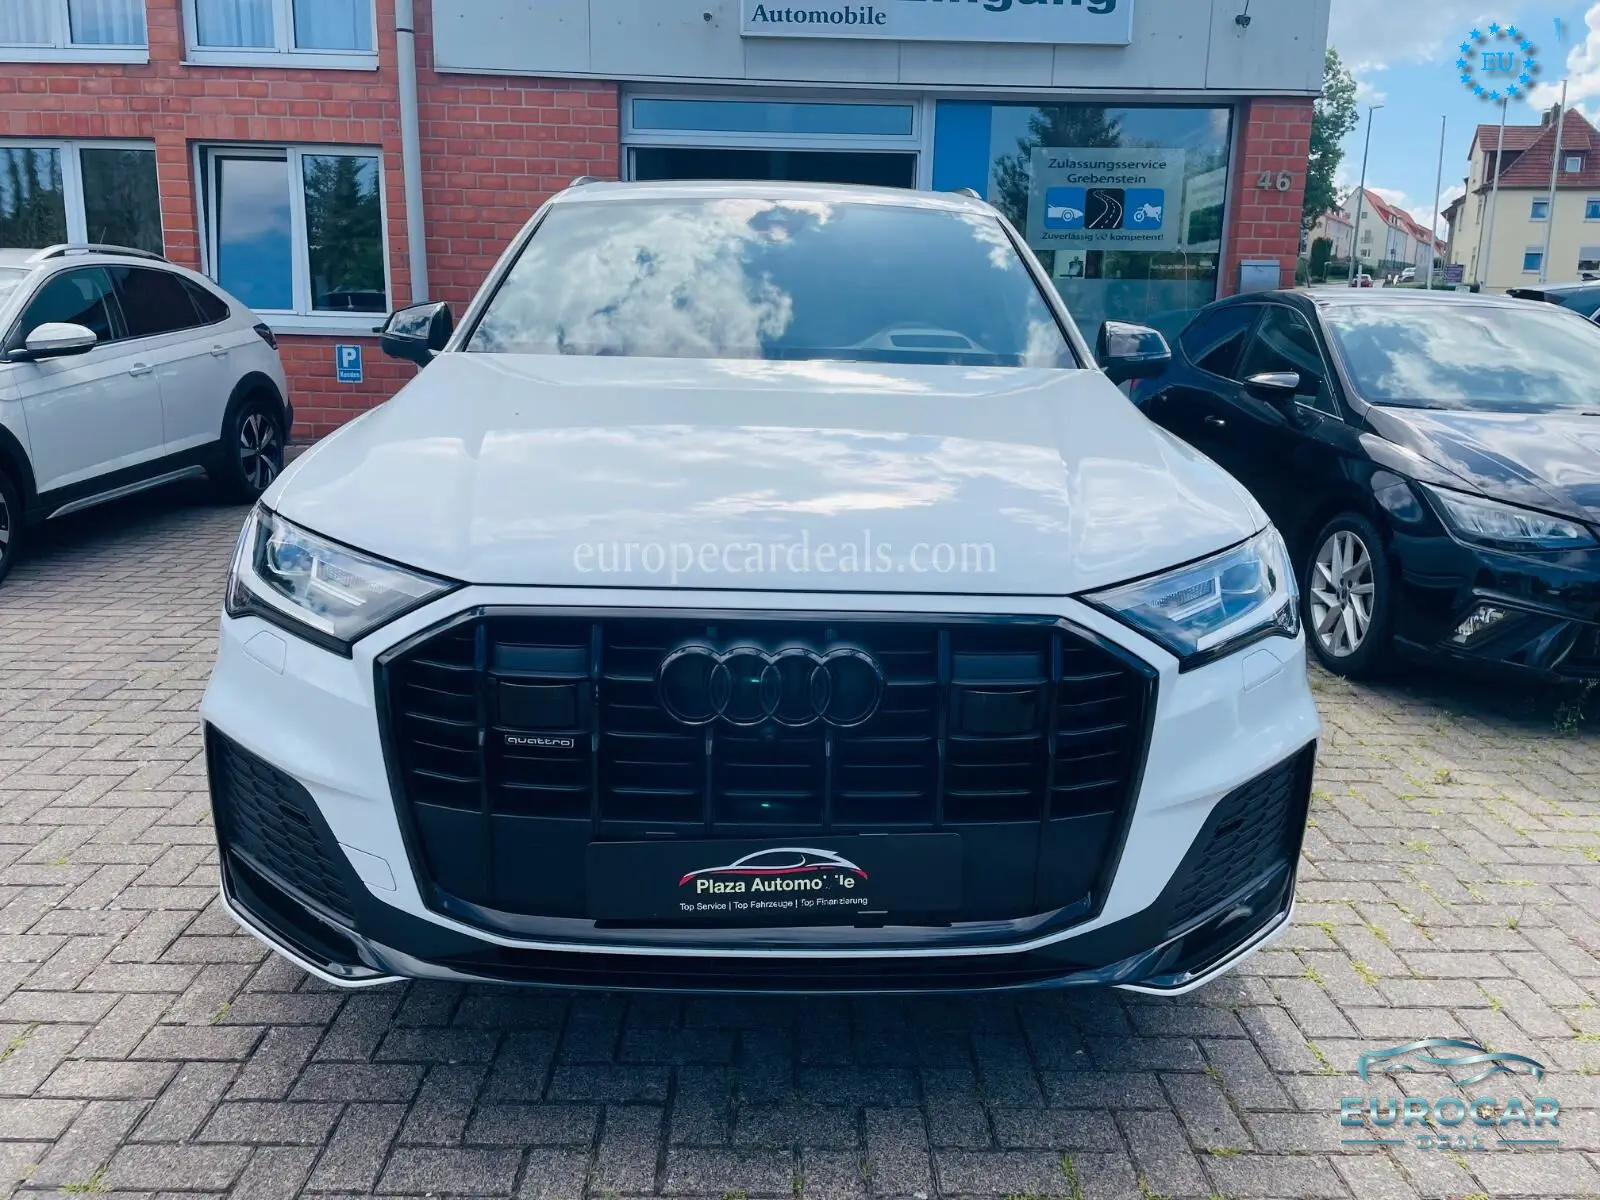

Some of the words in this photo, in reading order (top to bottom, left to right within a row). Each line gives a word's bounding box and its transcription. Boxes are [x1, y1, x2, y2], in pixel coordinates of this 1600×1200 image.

[752, 4, 887, 25] Automobile
[1048, 158, 1167, 171] Zulassungsservice
[1067, 173, 1146, 184] Grebenstein
[1256, 169, 1291, 192] 46
[1042, 232, 1093, 242] Zuverlässig
[1110, 233, 1164, 242] kompetent!
[342, 347, 356, 368] P
[507, 737, 571, 746] quattro
[696, 878, 746, 894] Plaza
[680, 902, 695, 912] Top
[697, 902, 727, 911] Service
[733, 901, 749, 910] Top
[750, 900, 793, 909] Fahrzeuge
